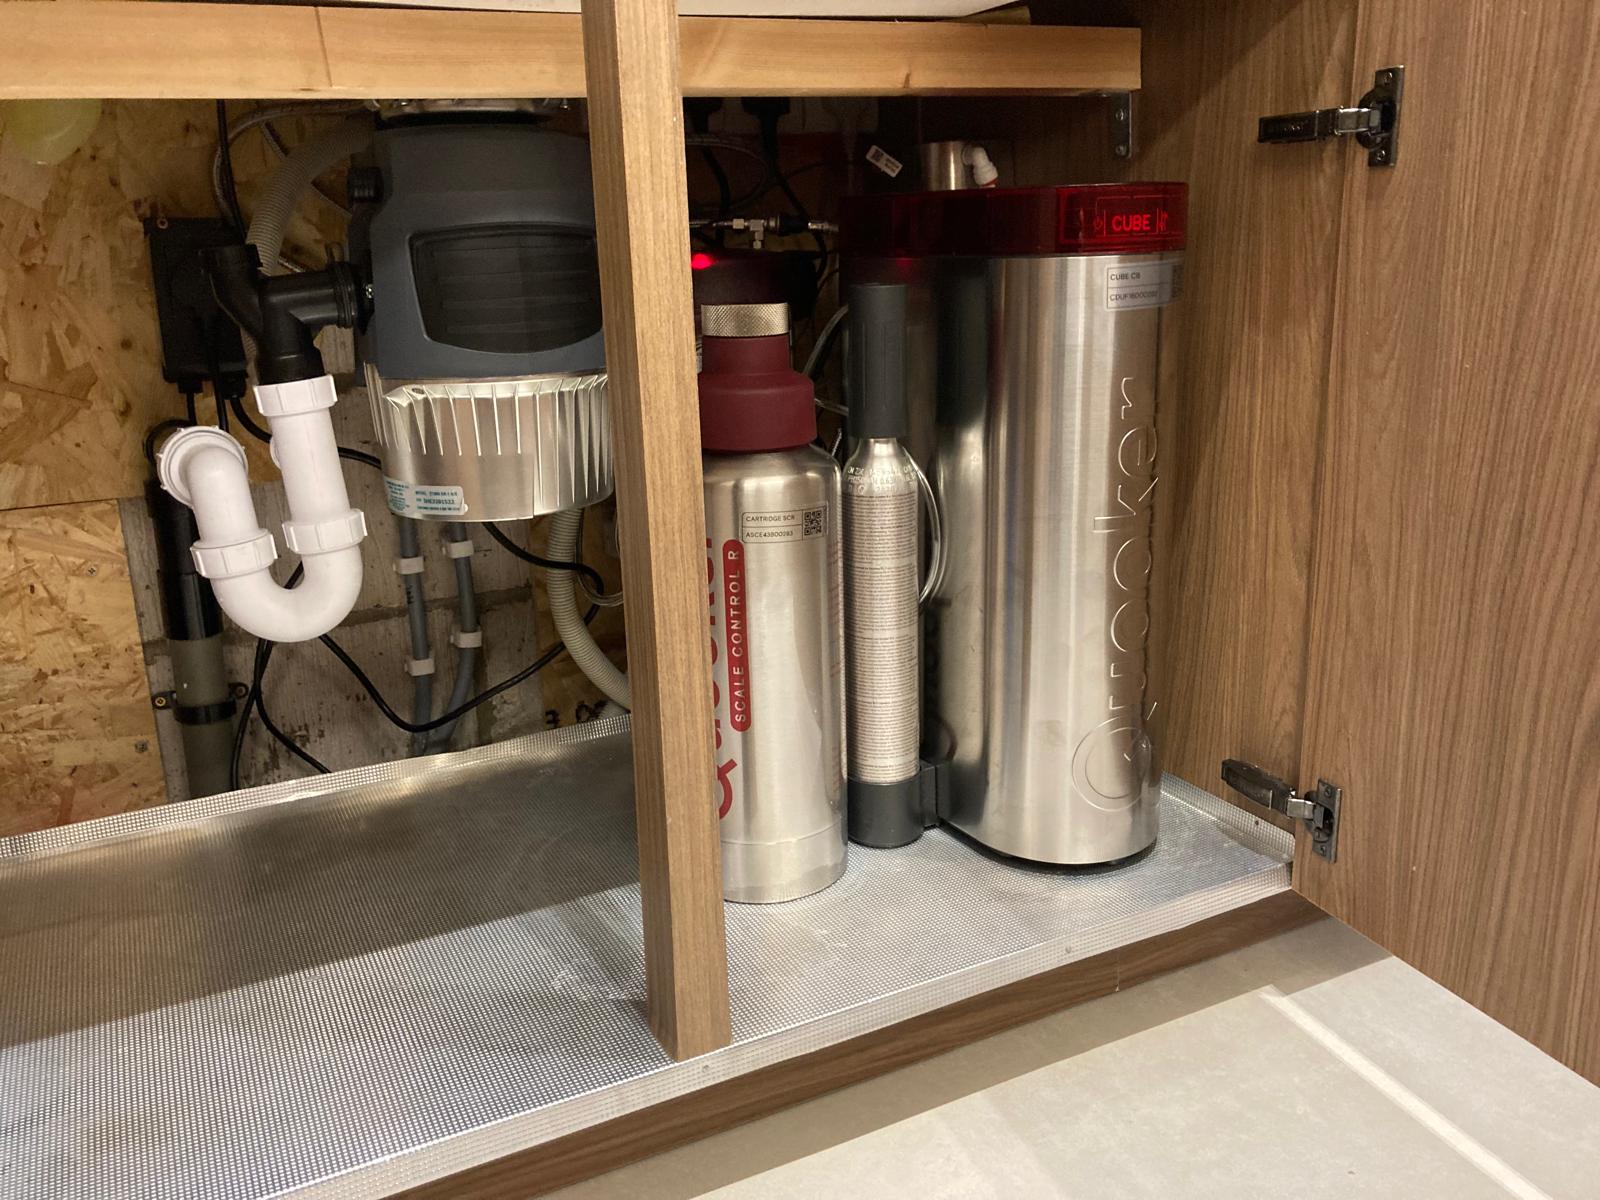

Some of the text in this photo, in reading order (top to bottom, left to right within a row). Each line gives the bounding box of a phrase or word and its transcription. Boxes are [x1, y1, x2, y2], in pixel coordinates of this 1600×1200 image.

[1111, 213, 1151, 232] CUBE
[1110, 272, 1129, 281] CUBE
[728, 550, 746, 723] SCALE CONTROL R
